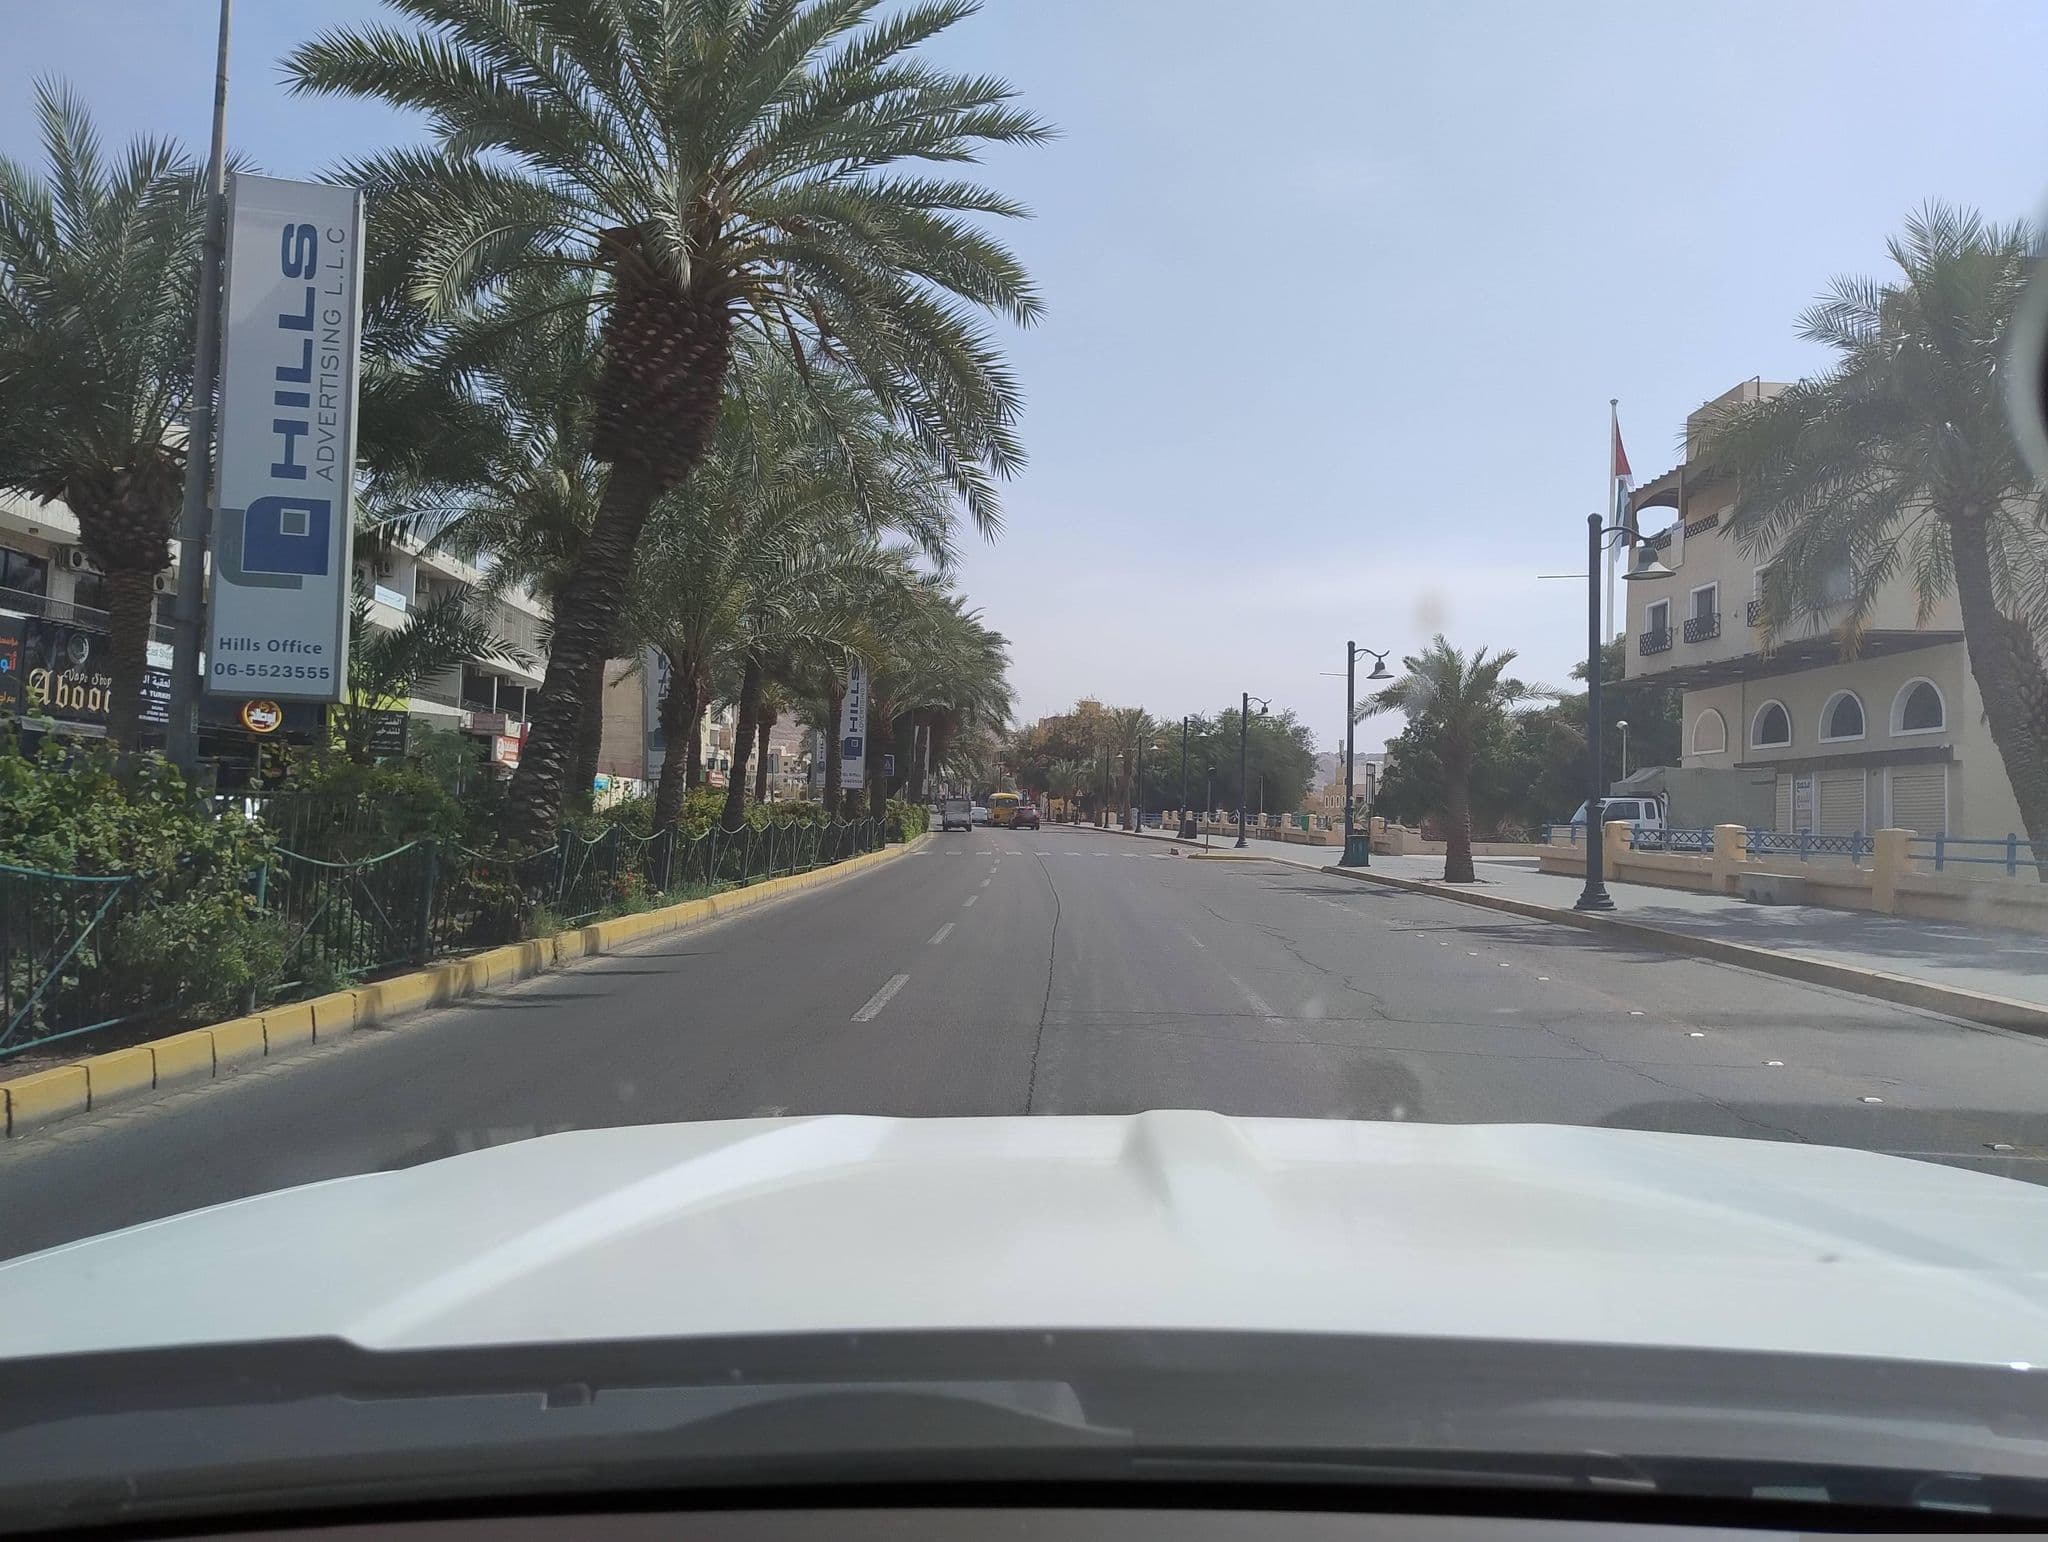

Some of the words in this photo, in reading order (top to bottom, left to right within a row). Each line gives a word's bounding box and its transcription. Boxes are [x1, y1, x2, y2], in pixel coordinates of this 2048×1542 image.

[325, 228, 345, 295] L.L.C
[271, 223, 318, 480] HILLS
[316, 309, 342, 481] ADVERTISING
[214, 662, 330, 680] 06-5523555
[219, 637, 261, 652] Hills
[267, 639, 323, 655] Office
